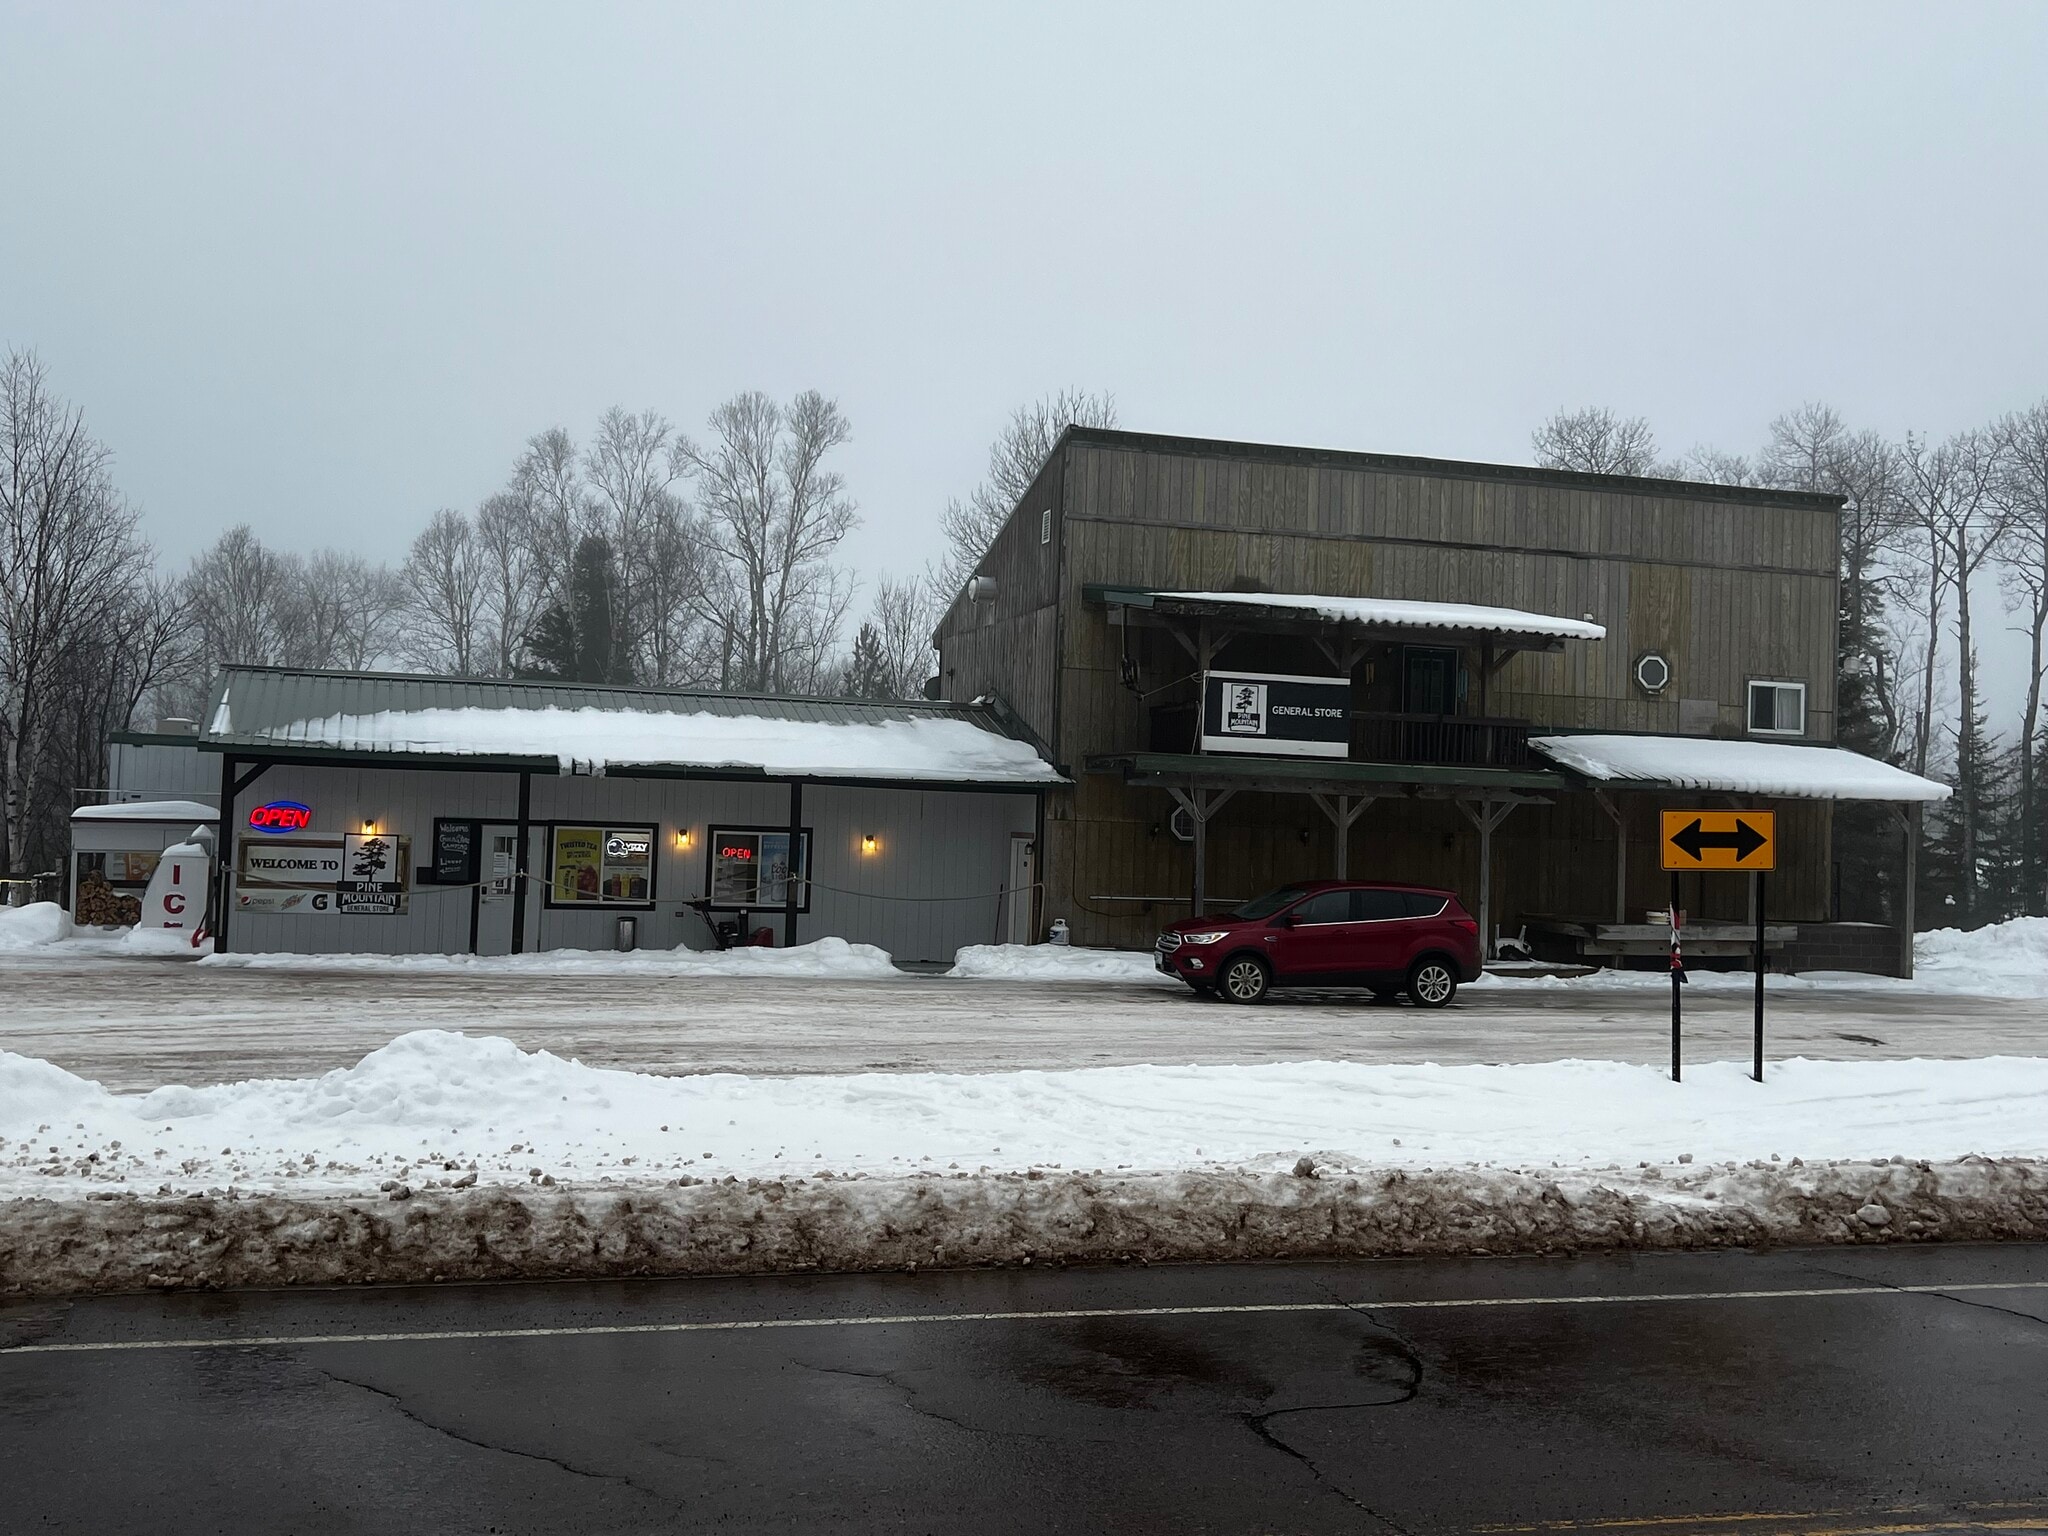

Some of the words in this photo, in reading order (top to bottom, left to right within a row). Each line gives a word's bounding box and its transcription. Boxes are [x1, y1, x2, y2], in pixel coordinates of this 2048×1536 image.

[1272, 706, 1313, 716] GENERAL
[1314, 708, 1343, 718] STORE
[1230, 718, 1258, 726] MOUNTAIN
[250, 806, 312, 828] OPEN
[722, 847, 751, 859] OPEN
[251, 858, 317, 870] WELCOME
[321, 860, 338, 870] TO
[356, 882, 384, 892] PINE
[251, 898, 275, 906] pepsi
[312, 894, 328, 910] G
[341, 892, 397, 905] MOUNTAIN
